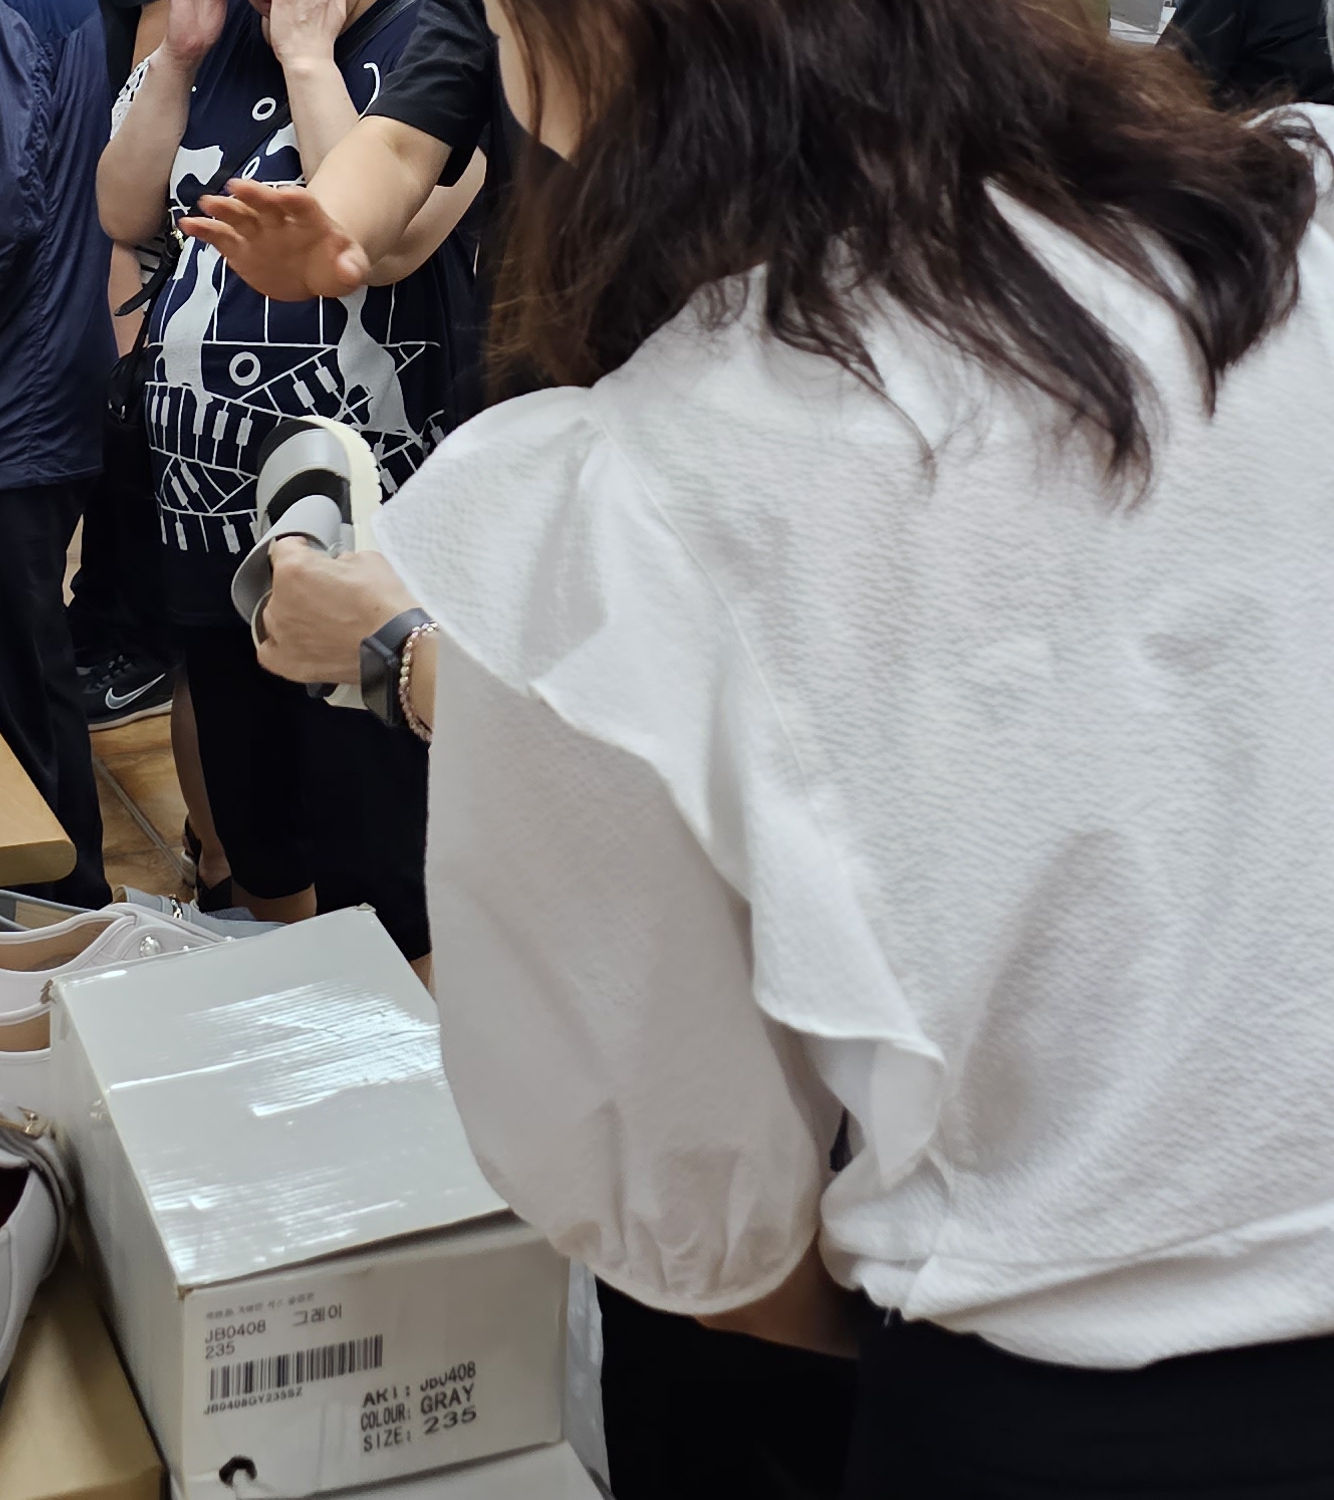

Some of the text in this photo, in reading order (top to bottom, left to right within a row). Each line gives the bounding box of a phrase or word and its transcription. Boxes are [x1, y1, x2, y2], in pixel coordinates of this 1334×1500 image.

[204, 1319, 267, 1344] JB0408
[292, 1303, 342, 1328] 그레이
[204, 1342, 236, 1360] 235
[361, 1383, 475, 1432] COLOUR: GRAY
[363, 1404, 477, 1452] SIZE: 235
